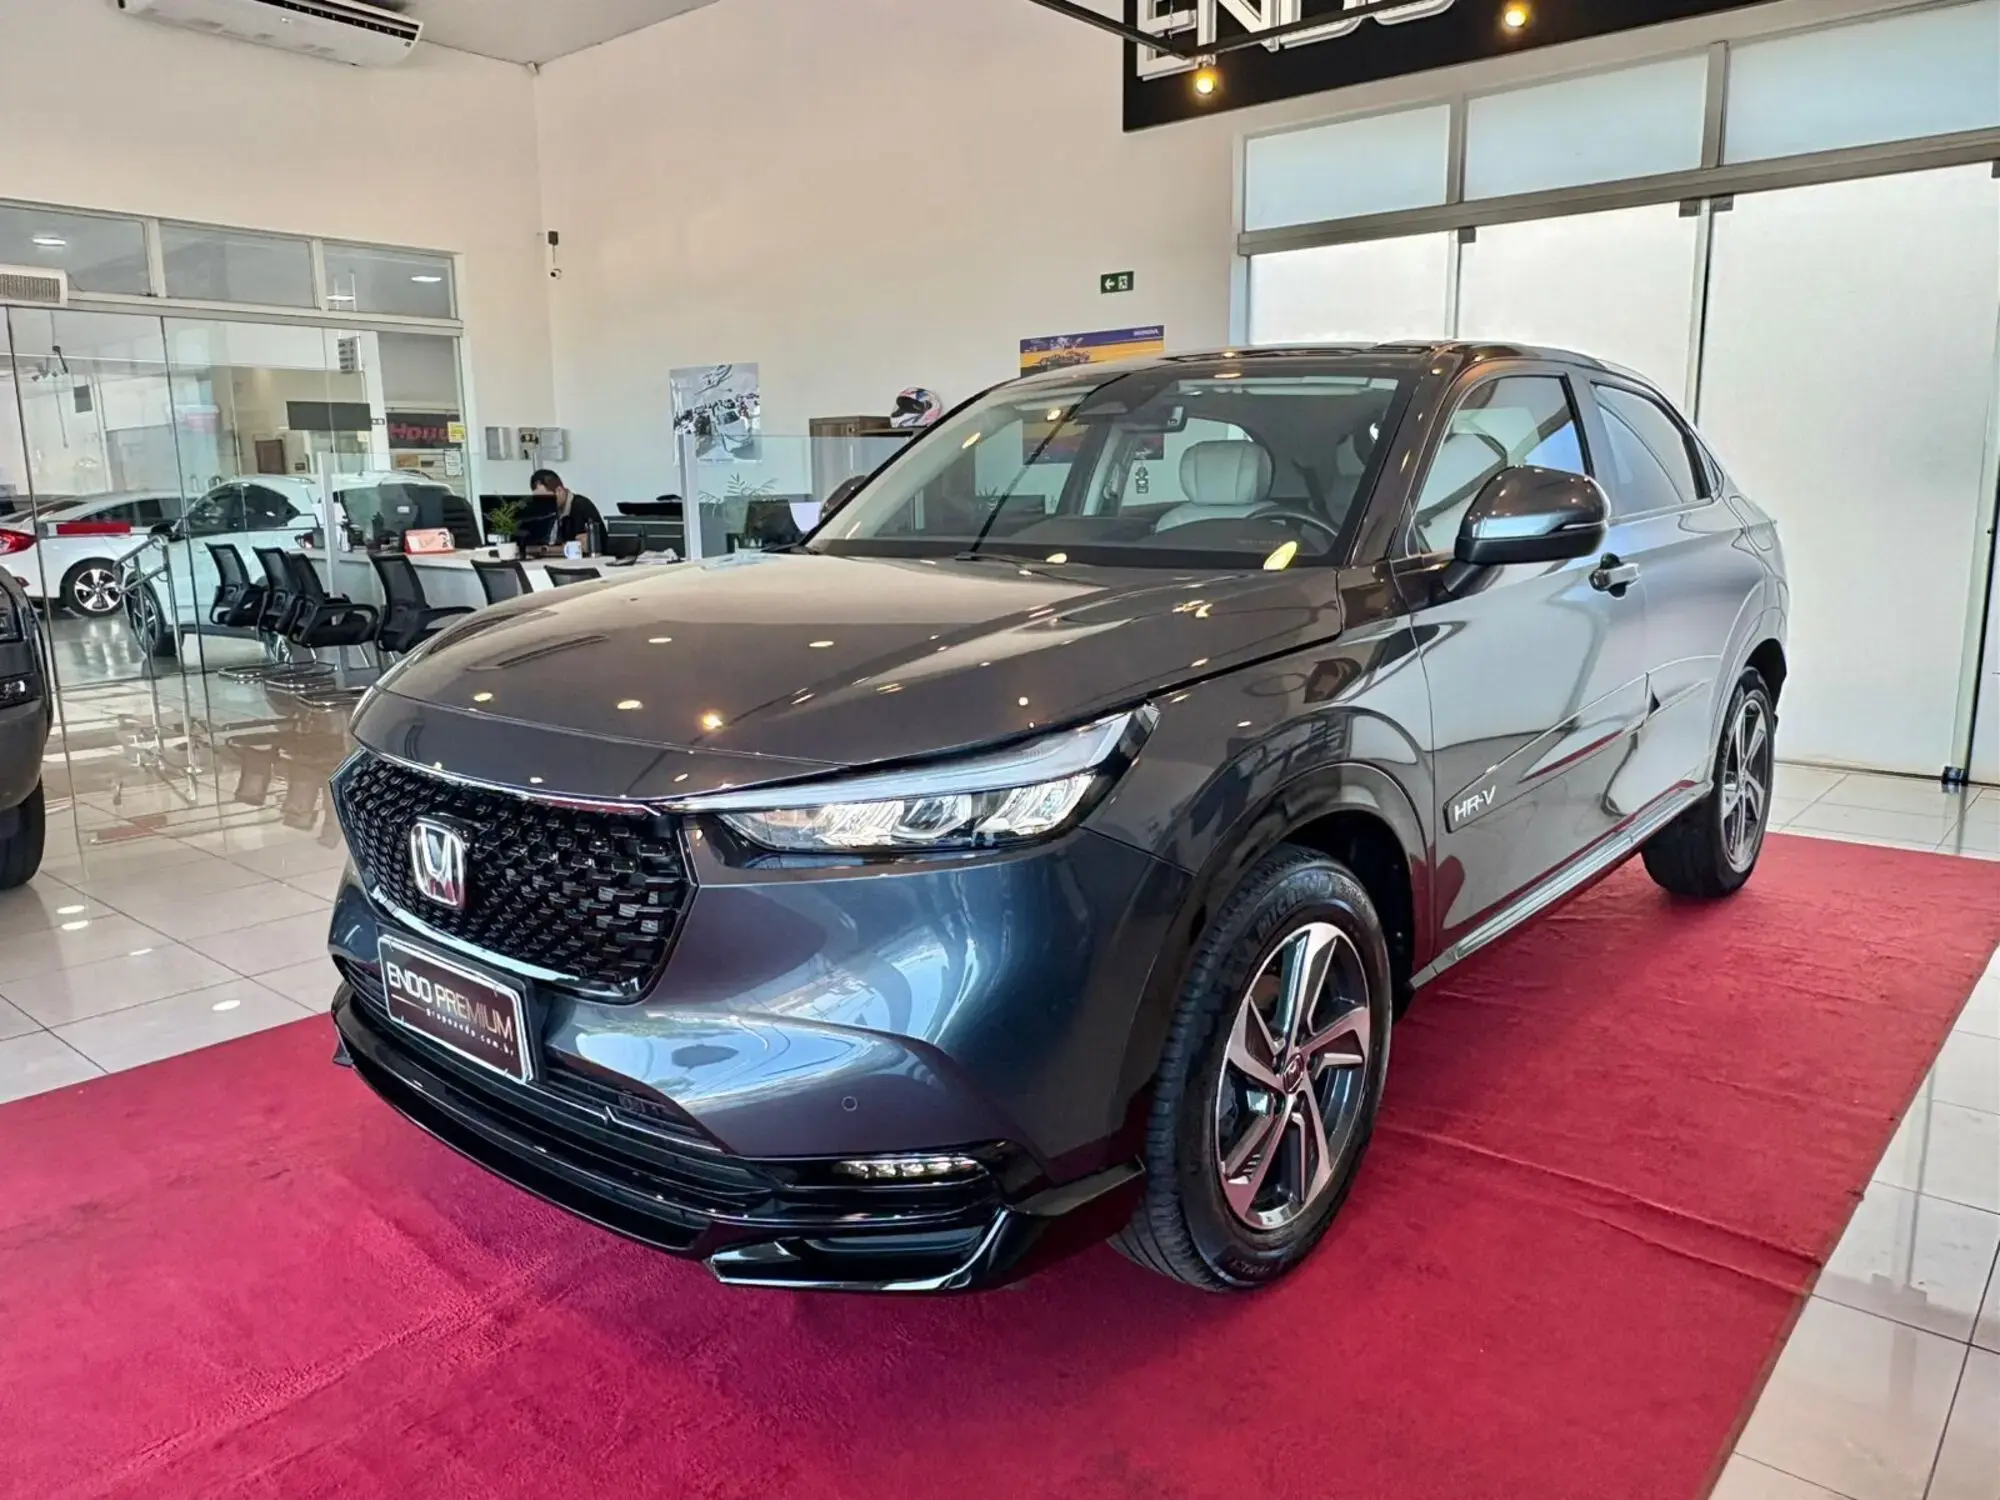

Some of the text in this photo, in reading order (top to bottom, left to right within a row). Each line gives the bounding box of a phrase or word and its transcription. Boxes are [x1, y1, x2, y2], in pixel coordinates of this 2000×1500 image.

[1454, 784, 1497, 822] HR-V
[386, 960, 514, 1043] ENDO PREMIUM
